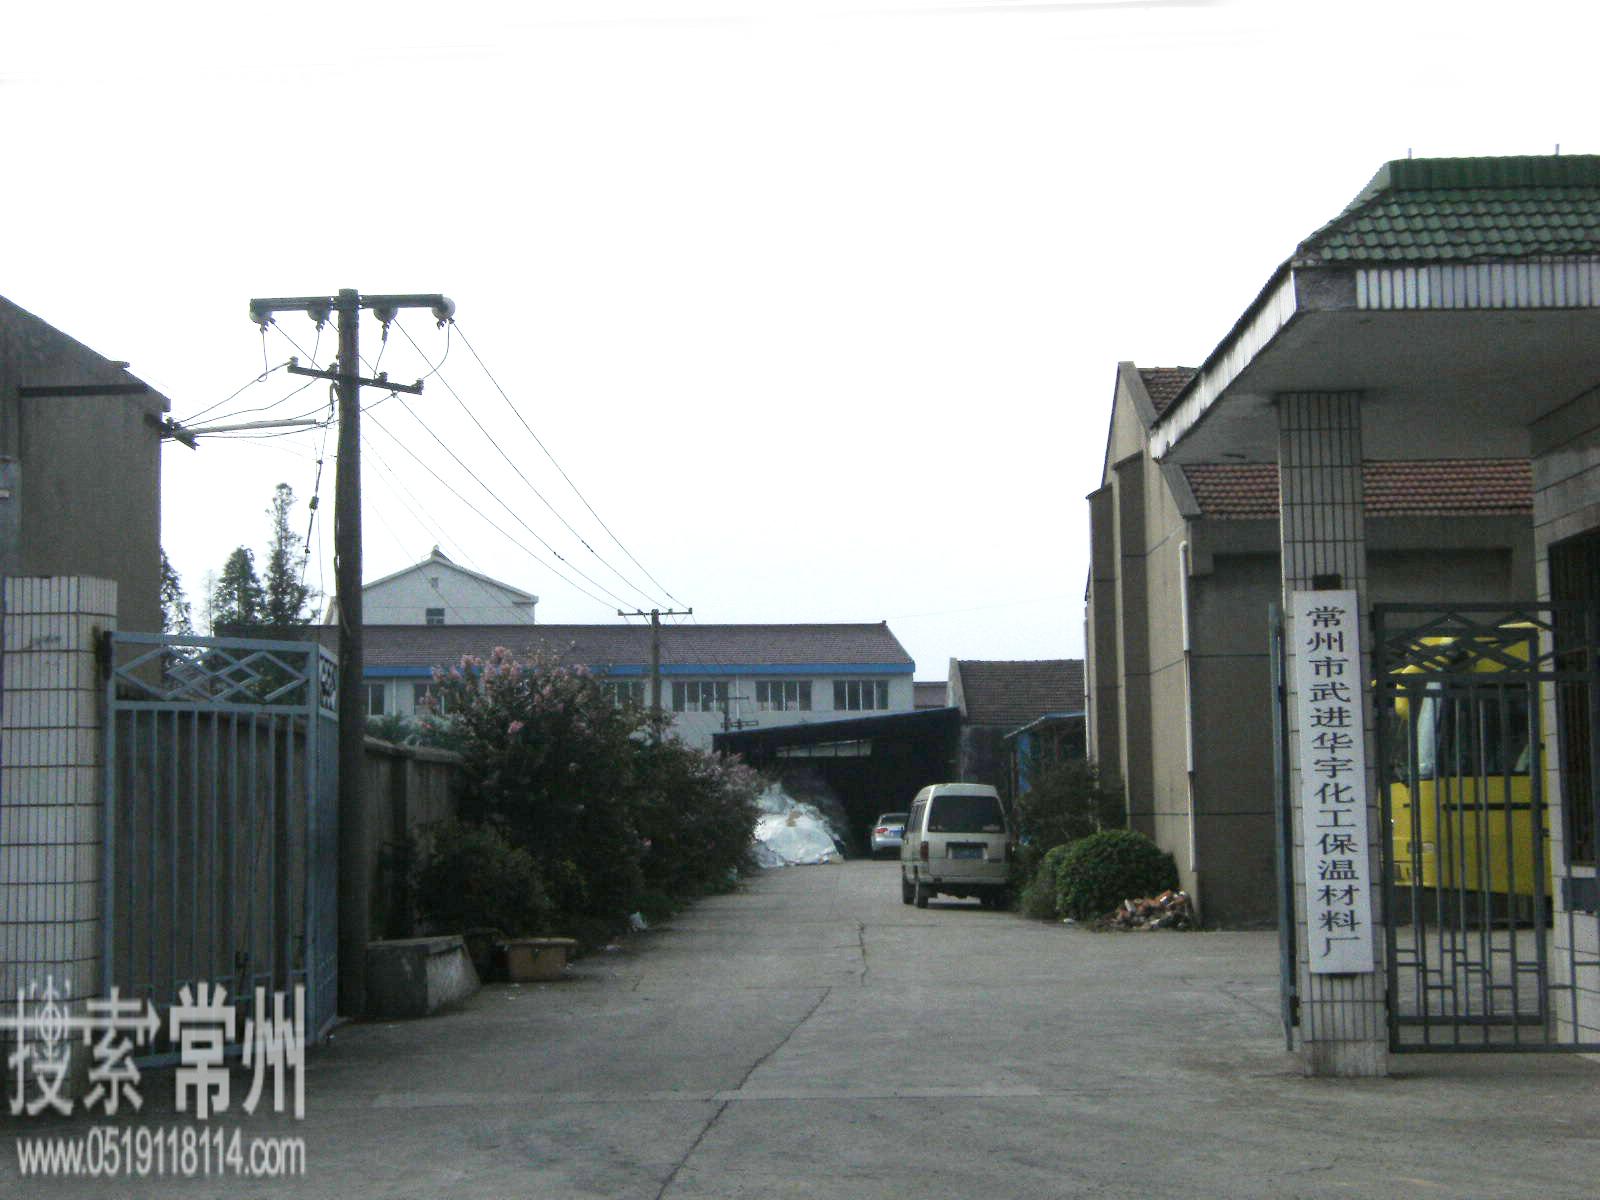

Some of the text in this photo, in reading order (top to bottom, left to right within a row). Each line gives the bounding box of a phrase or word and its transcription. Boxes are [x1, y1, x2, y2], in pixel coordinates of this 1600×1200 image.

[1305, 605, 1361, 958] 常州市武进华宇化工保温材料厂
